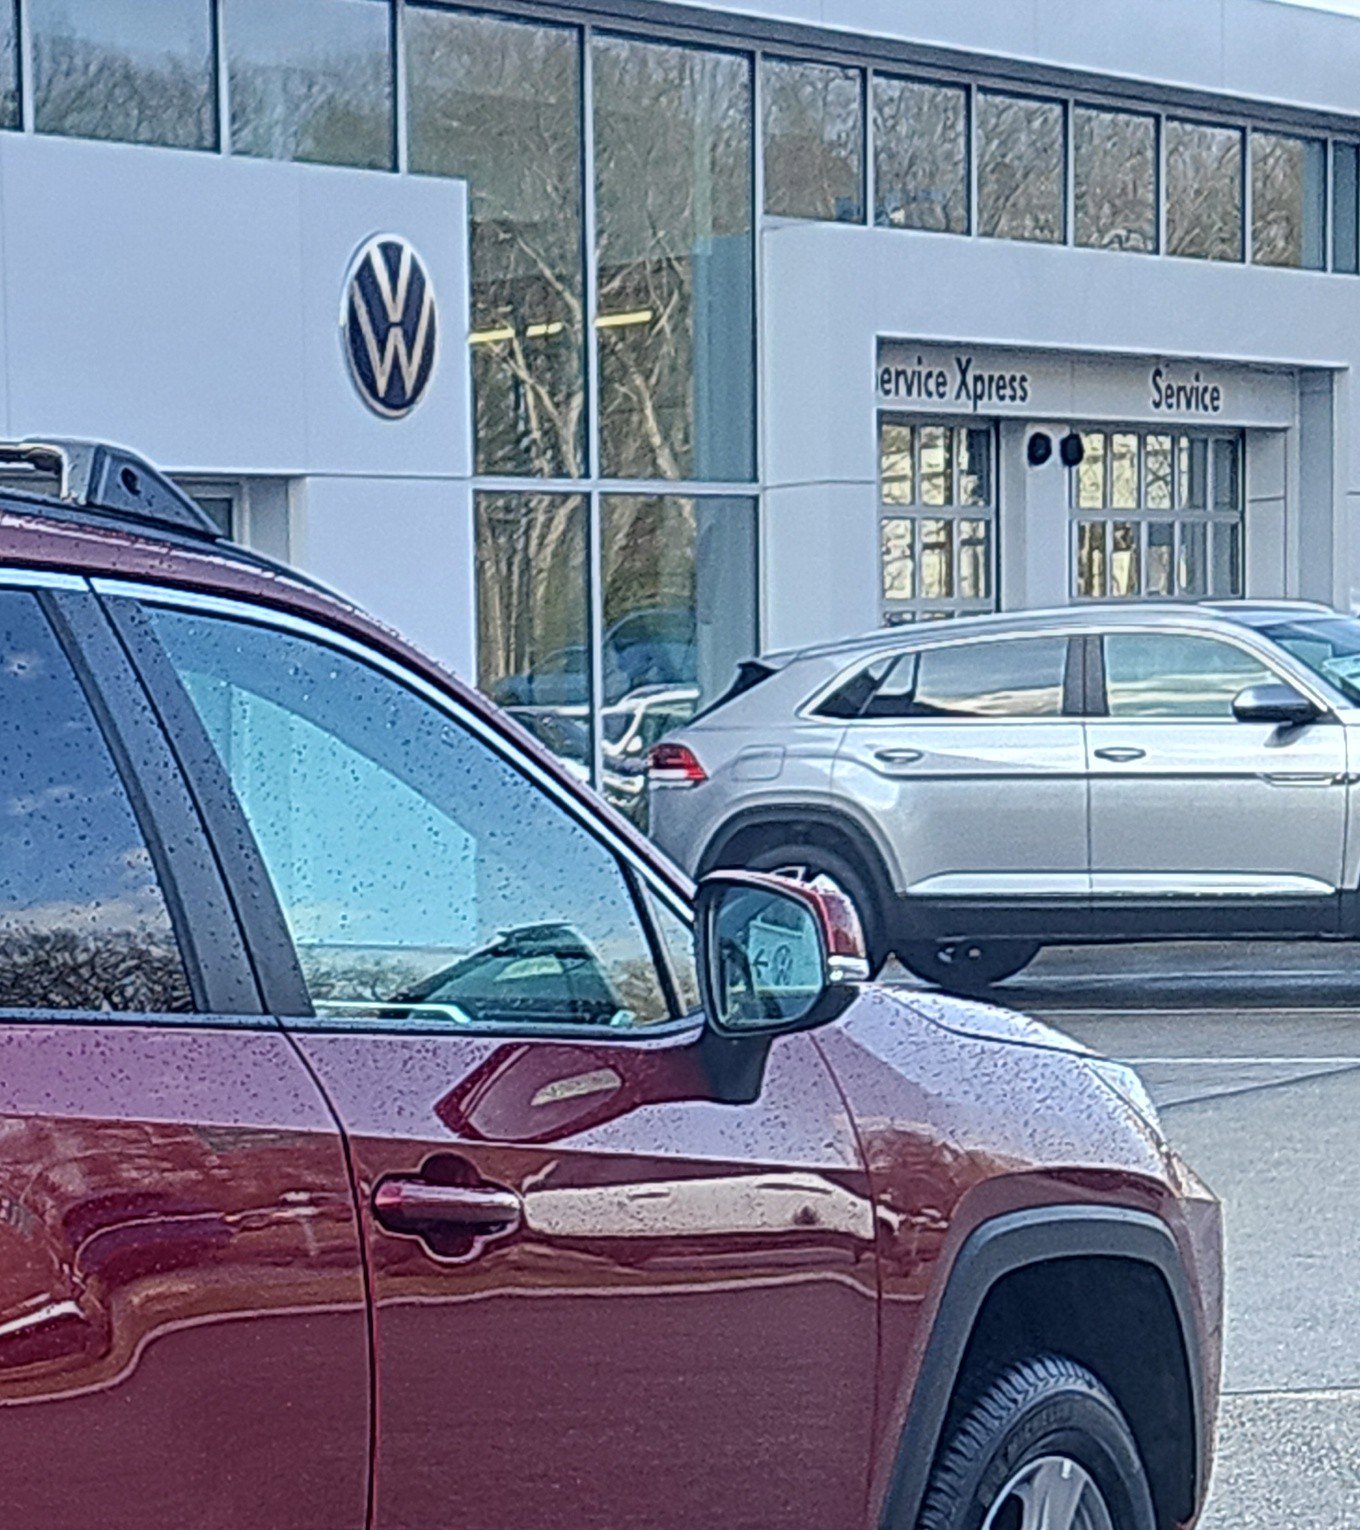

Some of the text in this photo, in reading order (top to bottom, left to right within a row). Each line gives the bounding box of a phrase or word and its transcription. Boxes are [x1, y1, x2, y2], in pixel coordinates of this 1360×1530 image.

[877, 356, 1029, 412] ervice Xpress
[1151, 366, 1221, 413] Service
